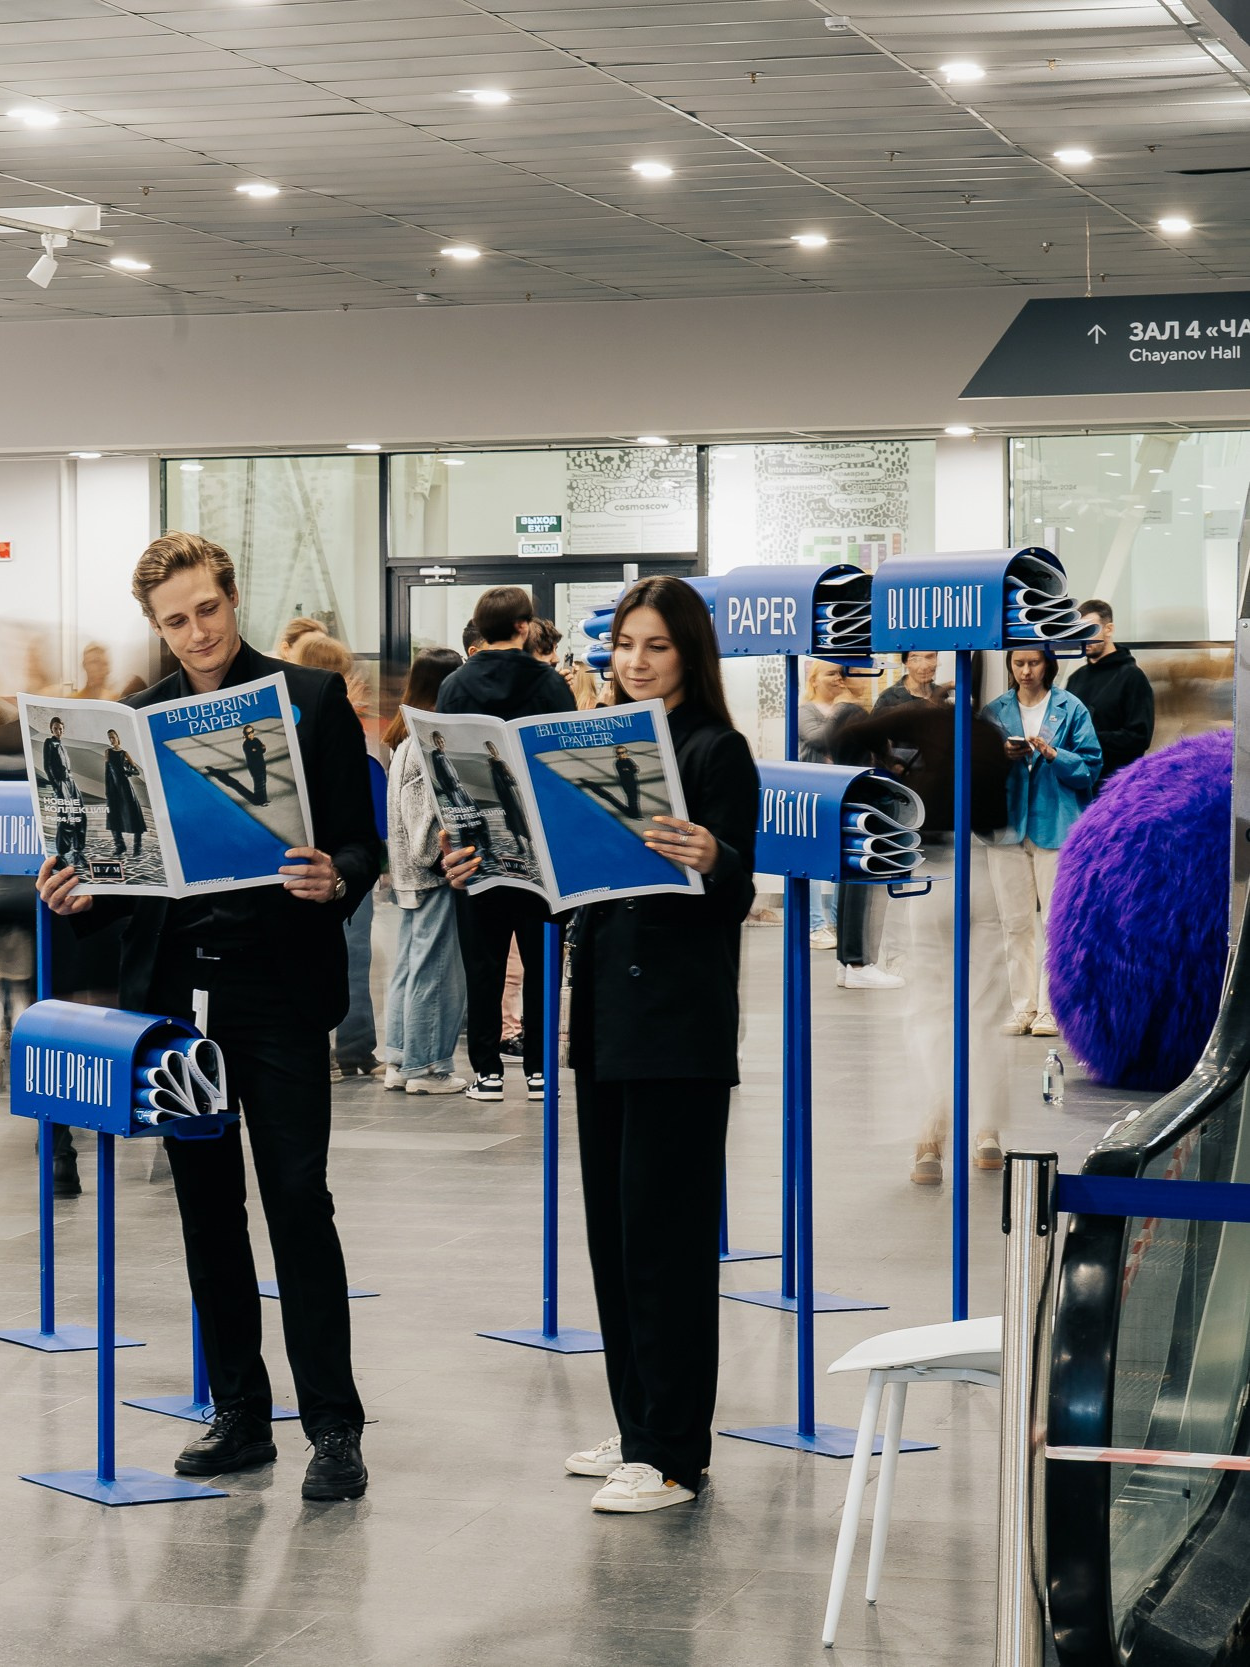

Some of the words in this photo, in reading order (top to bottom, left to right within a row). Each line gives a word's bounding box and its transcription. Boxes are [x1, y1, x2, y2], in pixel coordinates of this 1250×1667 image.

[1129, 321, 1179, 341] ЗАЛ
[1185, 320, 1201, 339] 4
[1129, 347, 1206, 364] Chayanov
[1211, 346, 1240, 360] Hall
[846, 482, 905, 492] Contemporary
[614, 503, 669, 511] cosmoscow
[521, 516, 557, 525] ВЫХОД
[728, 597, 797, 635] PAPER
[166, 691, 260, 724] BLUEPRINT
[188, 712, 243, 734] PAPER
[535, 714, 636, 738] BLUEPRINT
[558, 732, 615, 748] PAPER
[43, 797, 81, 806] НОВЫЕ
[45, 805, 110, 814] КОЛЛЕКЦИИ
[757, 787, 822, 839] PRiNT
